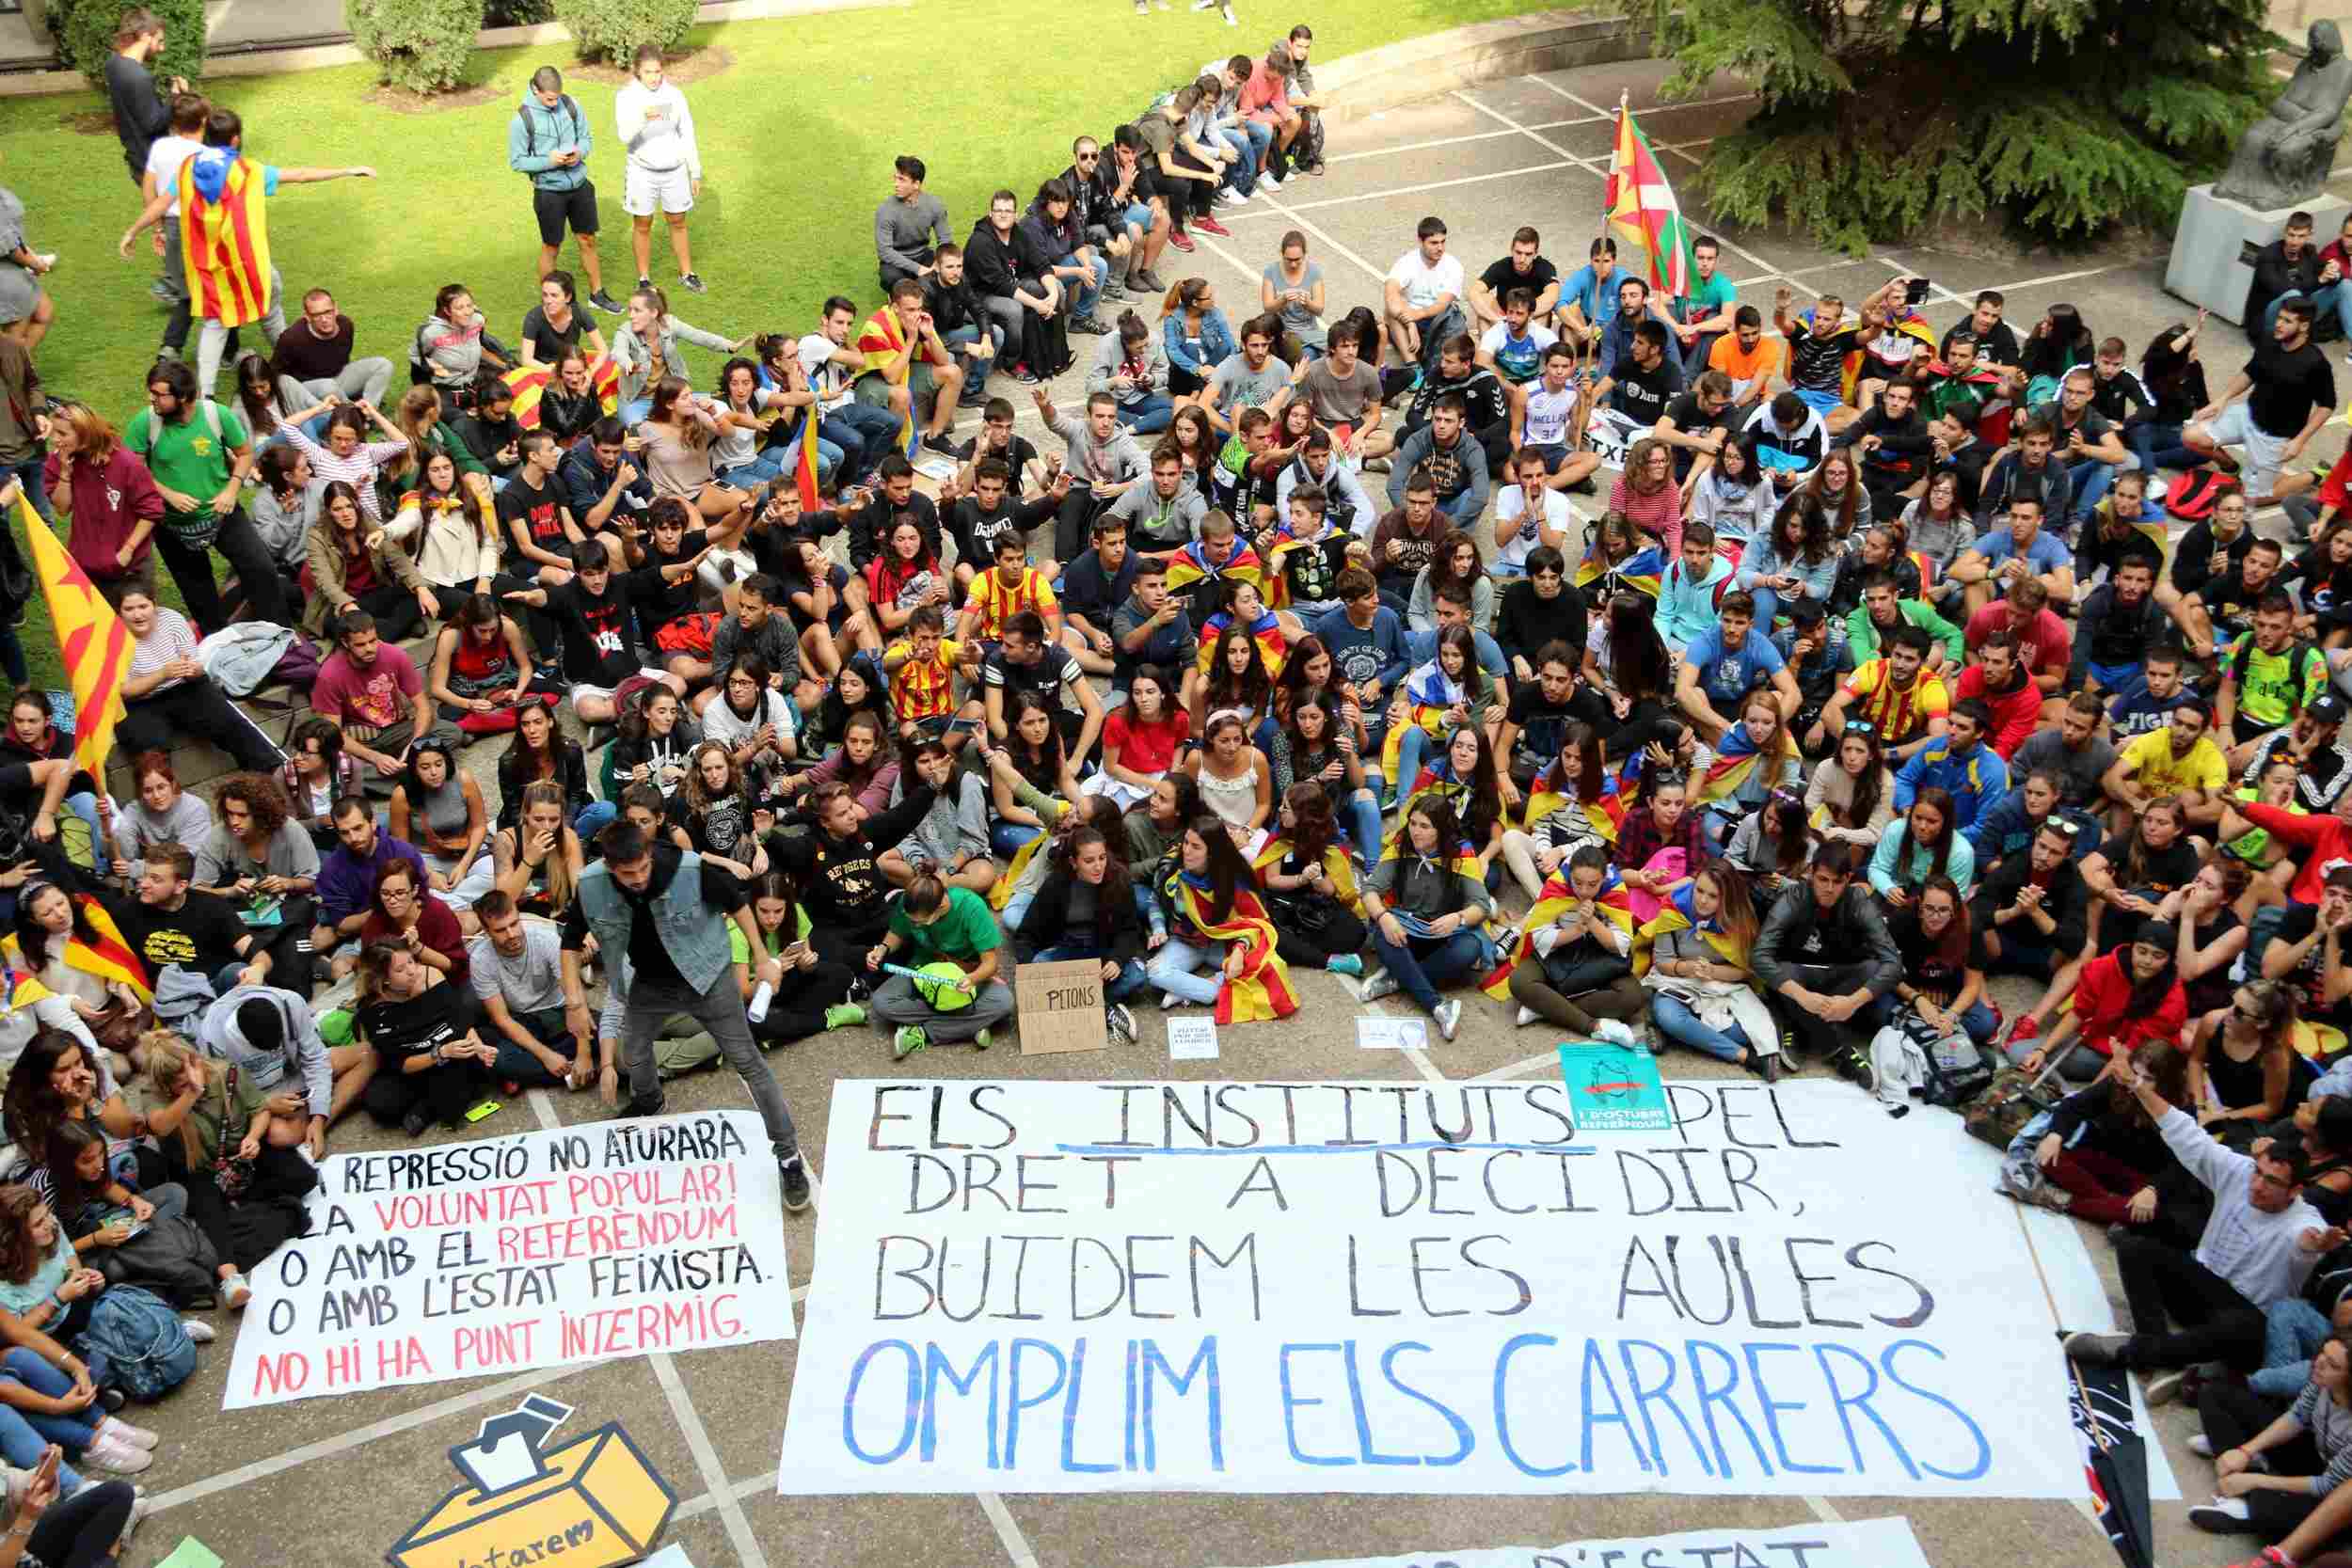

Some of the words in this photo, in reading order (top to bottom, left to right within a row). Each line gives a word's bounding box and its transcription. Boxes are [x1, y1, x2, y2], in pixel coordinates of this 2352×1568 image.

[549, 1135, 591, 1173] NO
[605, 1114, 746, 1168] ATURARÀ
[869, 1085, 1017, 1150] ELS
[1091, 1084, 1574, 1147] INSTITUTS
[1666, 1085, 1841, 1148] PEL
[375, 1181, 555, 1231] VOLUNTAT
[569, 1163, 738, 1209] POPULAR!
[904, 1153, 1142, 1214] DRET
[1226, 1156, 1288, 1212] A
[1376, 1148, 1804, 1217] DECIDIR,
[280, 1249, 309, 1288] O
[325, 1237, 416, 1286] AMB
[437, 1230, 488, 1270] EL
[498, 1204, 738, 1262] REFERÈNDUM
[873, 1232, 1261, 1322] BUIDEM
[1349, 1234, 1532, 1318] LES
[1617, 1235, 1935, 1330] AULES
[268, 1297, 296, 1336] O
[318, 1285, 399, 1333] AMB
[422, 1263, 564, 1317] L'ESTAT
[254, 1353, 310, 1397] NO
[377, 1337, 433, 1380] HA
[454, 1318, 541, 1368] PUNT
[843, 1337, 1224, 1473] OMPLIM
[1279, 1339, 1476, 1466] ELS
[1493, 1334, 1992, 1481] CARRERS
